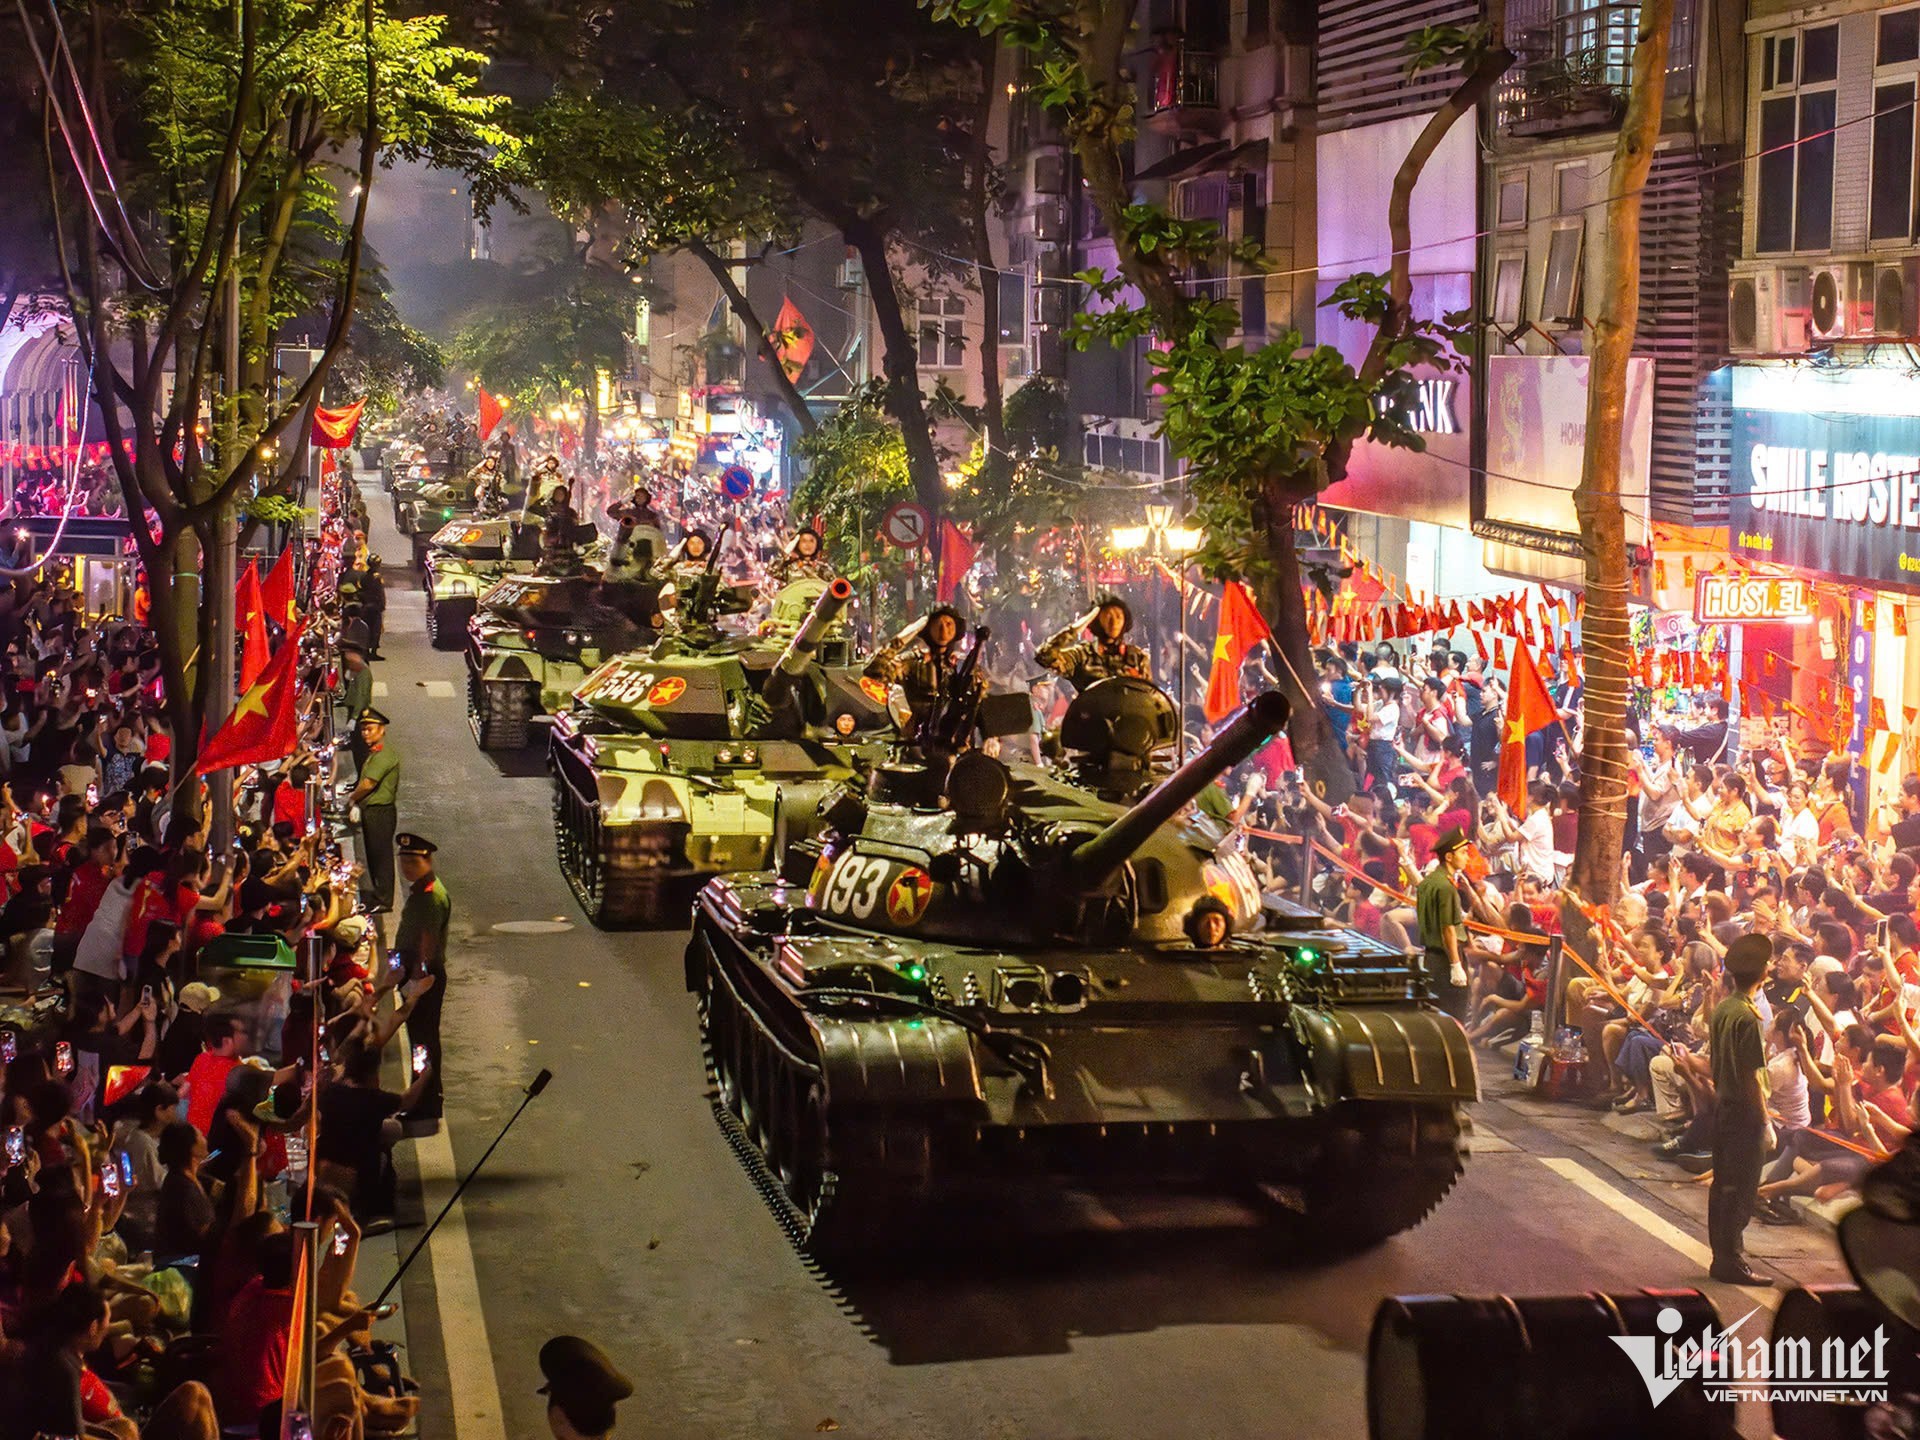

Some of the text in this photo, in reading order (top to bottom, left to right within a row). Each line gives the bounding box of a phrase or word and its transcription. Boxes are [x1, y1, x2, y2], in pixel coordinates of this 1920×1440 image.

[1751, 443, 1828, 520] SMILE
[1705, 580, 1807, 617] HOSTEL
[821, 845, 890, 919] 193
